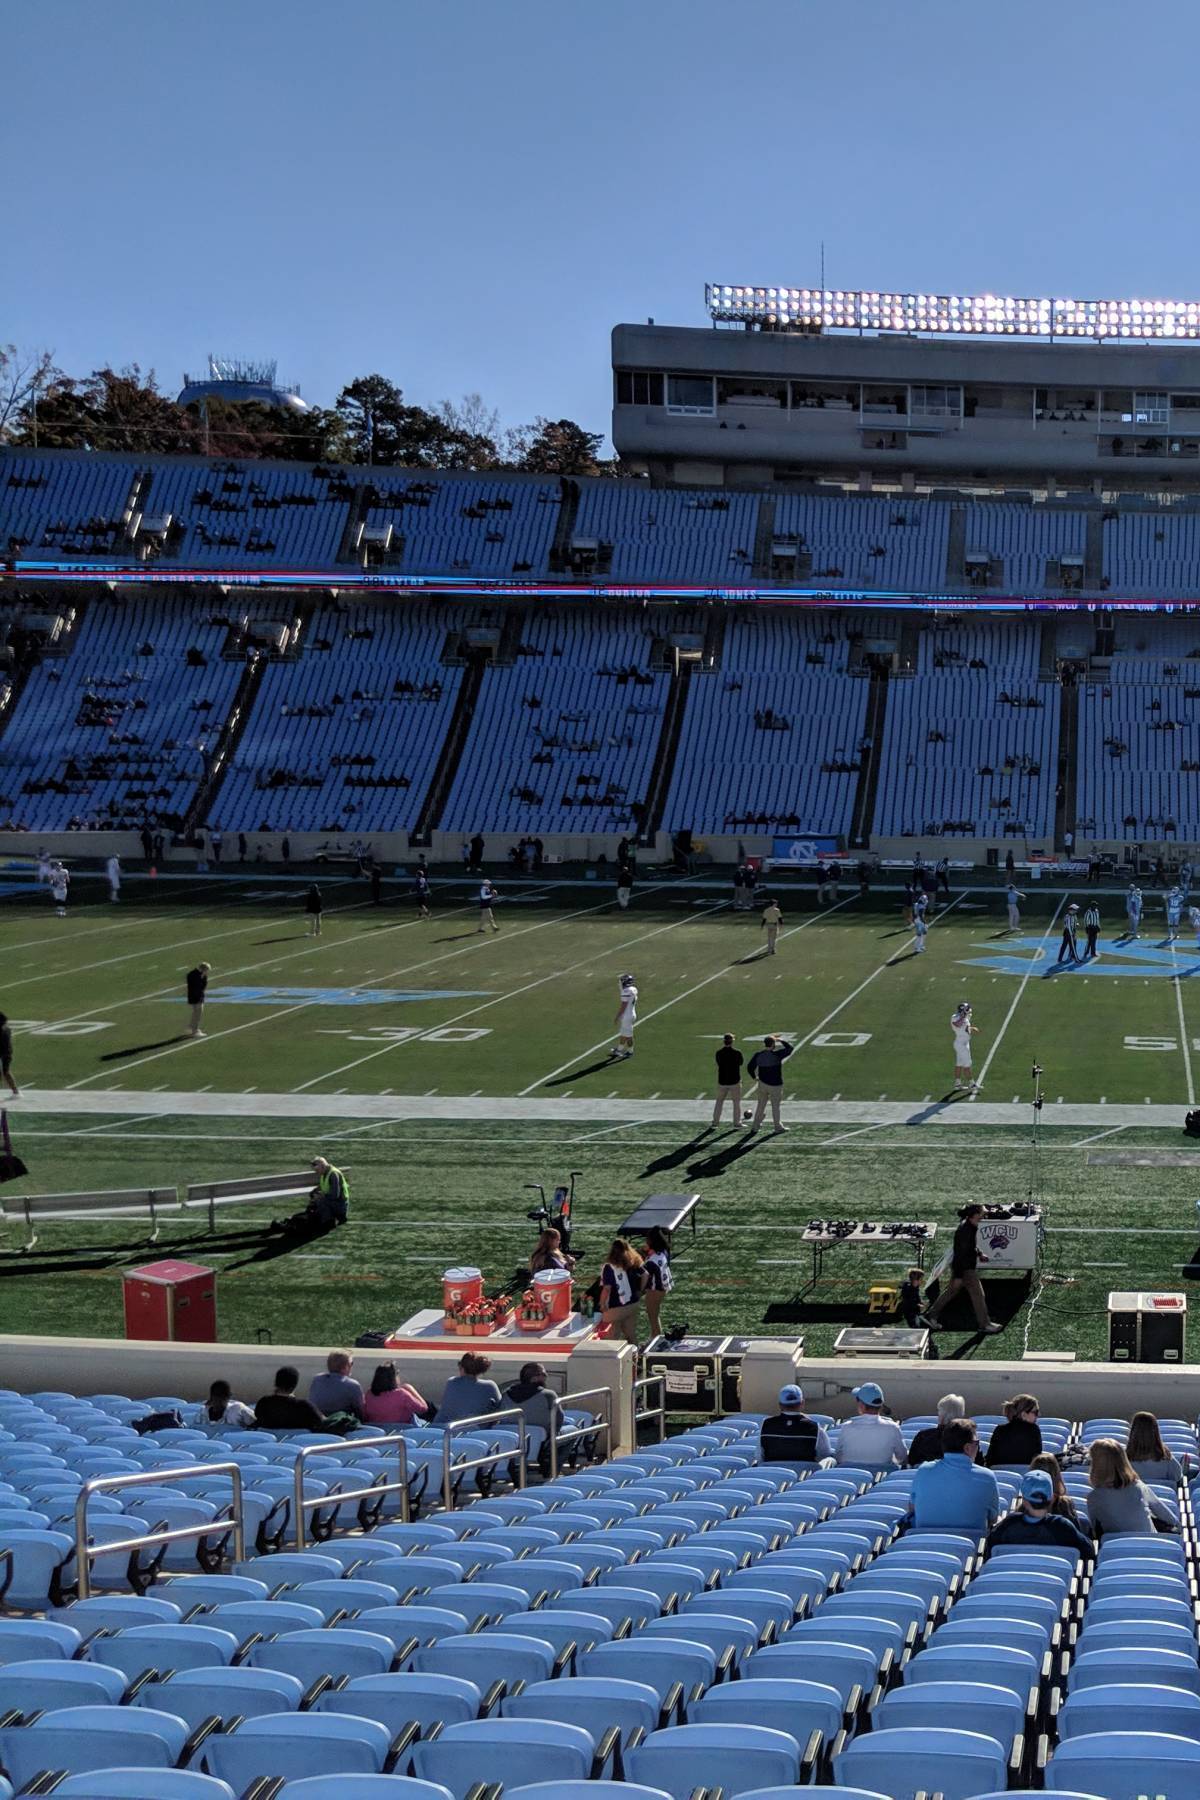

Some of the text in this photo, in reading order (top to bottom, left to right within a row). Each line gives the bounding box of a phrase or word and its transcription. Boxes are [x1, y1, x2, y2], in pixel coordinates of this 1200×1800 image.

[347, 1026, 494, 1042] 30
[981, 1224, 1018, 1240] WCU
[450, 1289, 462, 1302] G
[540, 1290, 553, 1304] G
